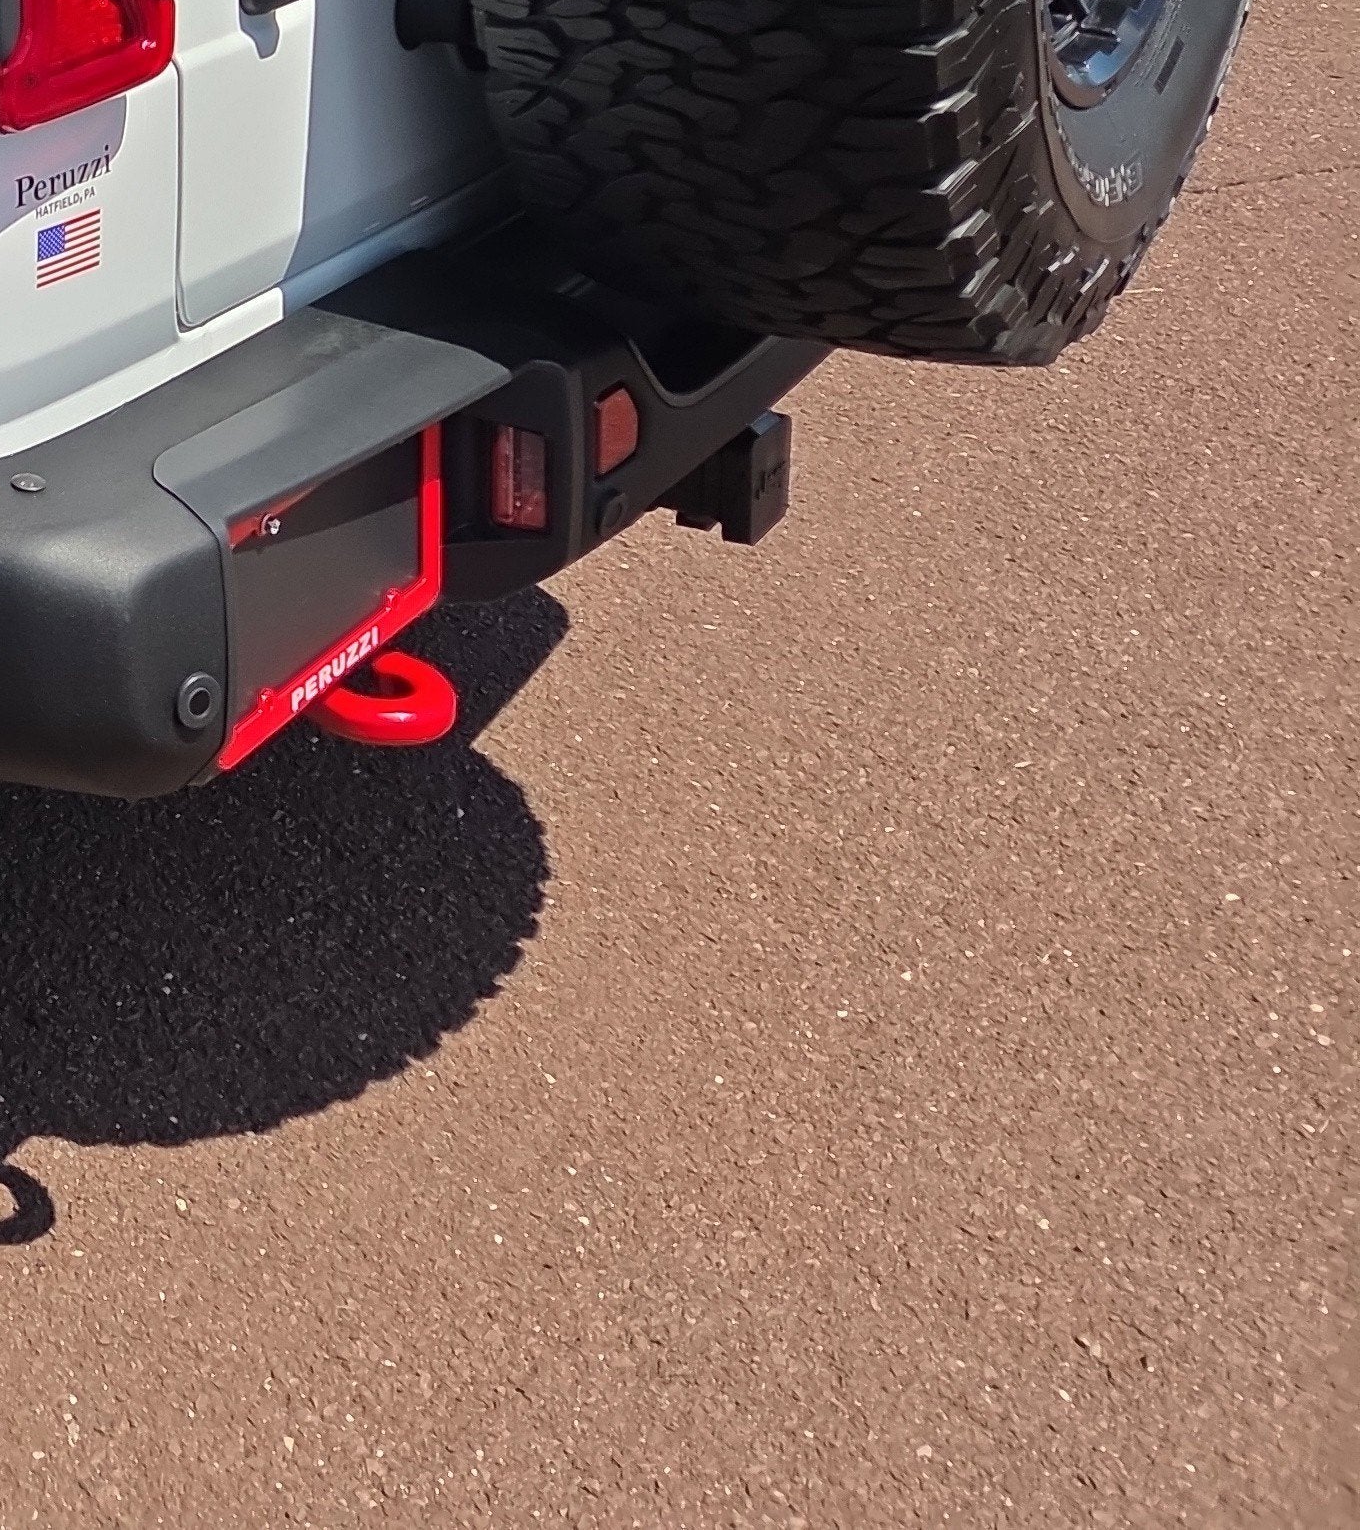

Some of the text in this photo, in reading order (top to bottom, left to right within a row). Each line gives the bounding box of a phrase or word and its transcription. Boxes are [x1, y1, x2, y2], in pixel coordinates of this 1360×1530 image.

[14, 144, 112, 209] Peruzzi
[35, 186, 96, 220] HATFIELD, PA
[290, 625, 379, 712] PERUZZI
